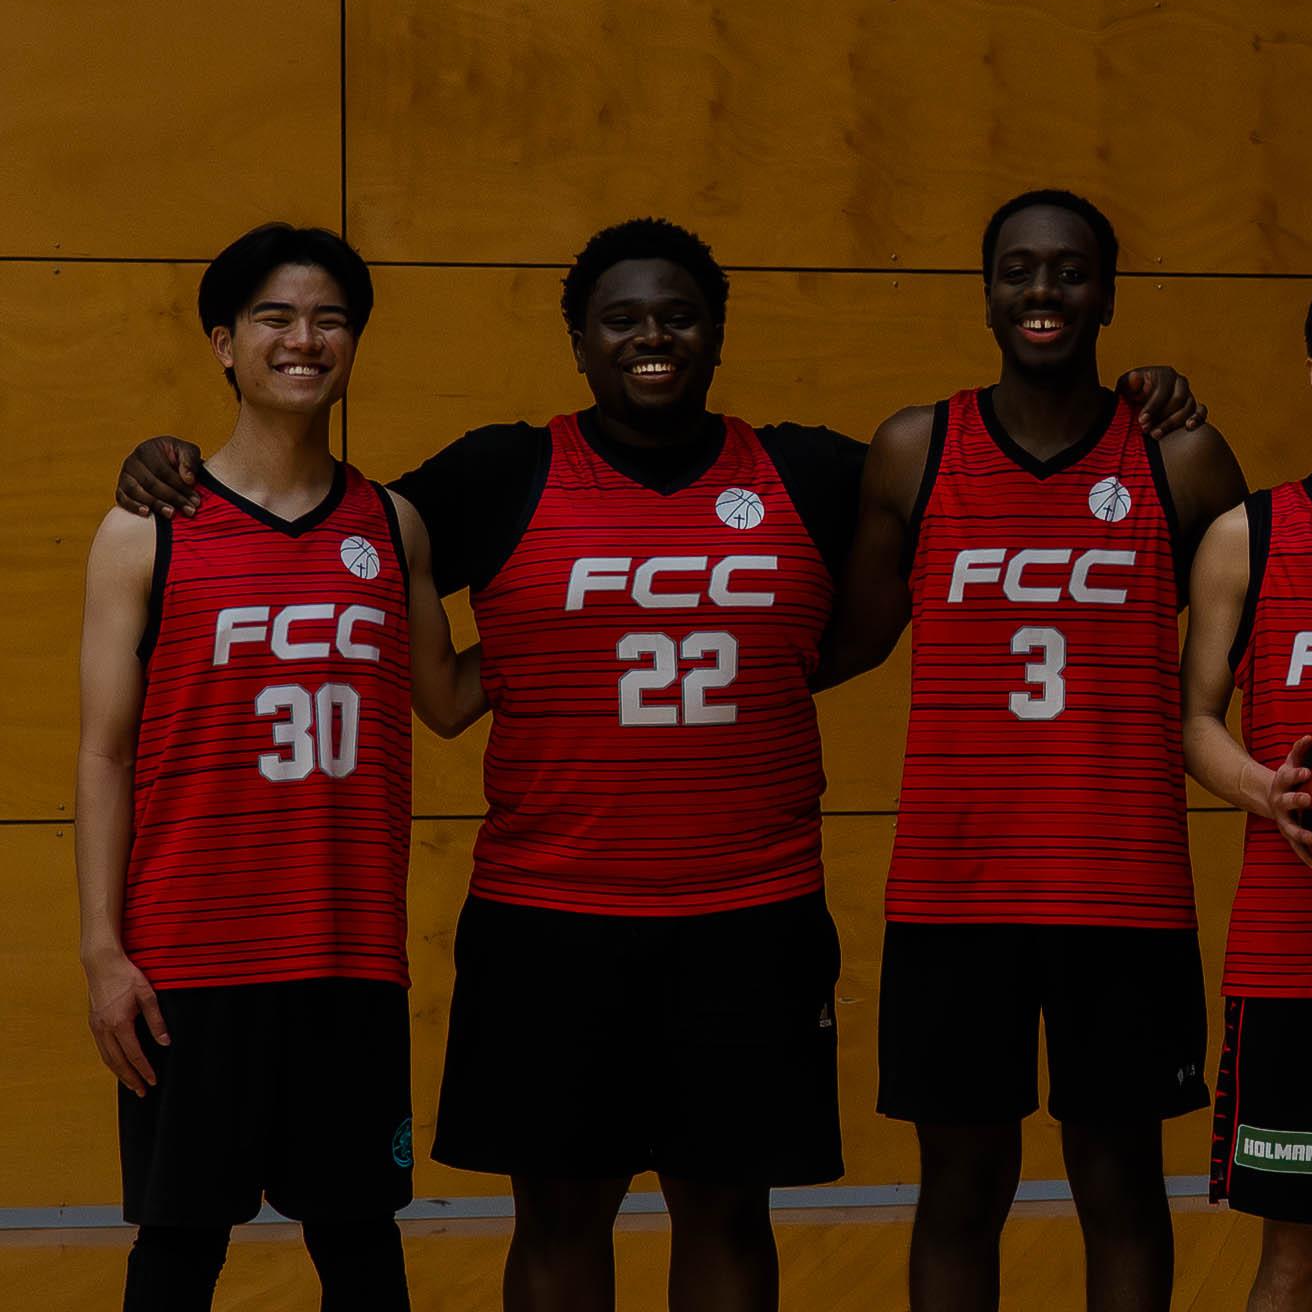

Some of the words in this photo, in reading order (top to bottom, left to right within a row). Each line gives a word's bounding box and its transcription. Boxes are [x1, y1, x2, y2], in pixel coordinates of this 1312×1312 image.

[565, 555, 778, 611] FCC
[946, 548, 1137, 604] FCC
[212, 604, 386, 666] FCC
[1008, 626, 1067, 720] 3
[617, 631, 740, 726] 22
[254, 682, 360, 783] 30
